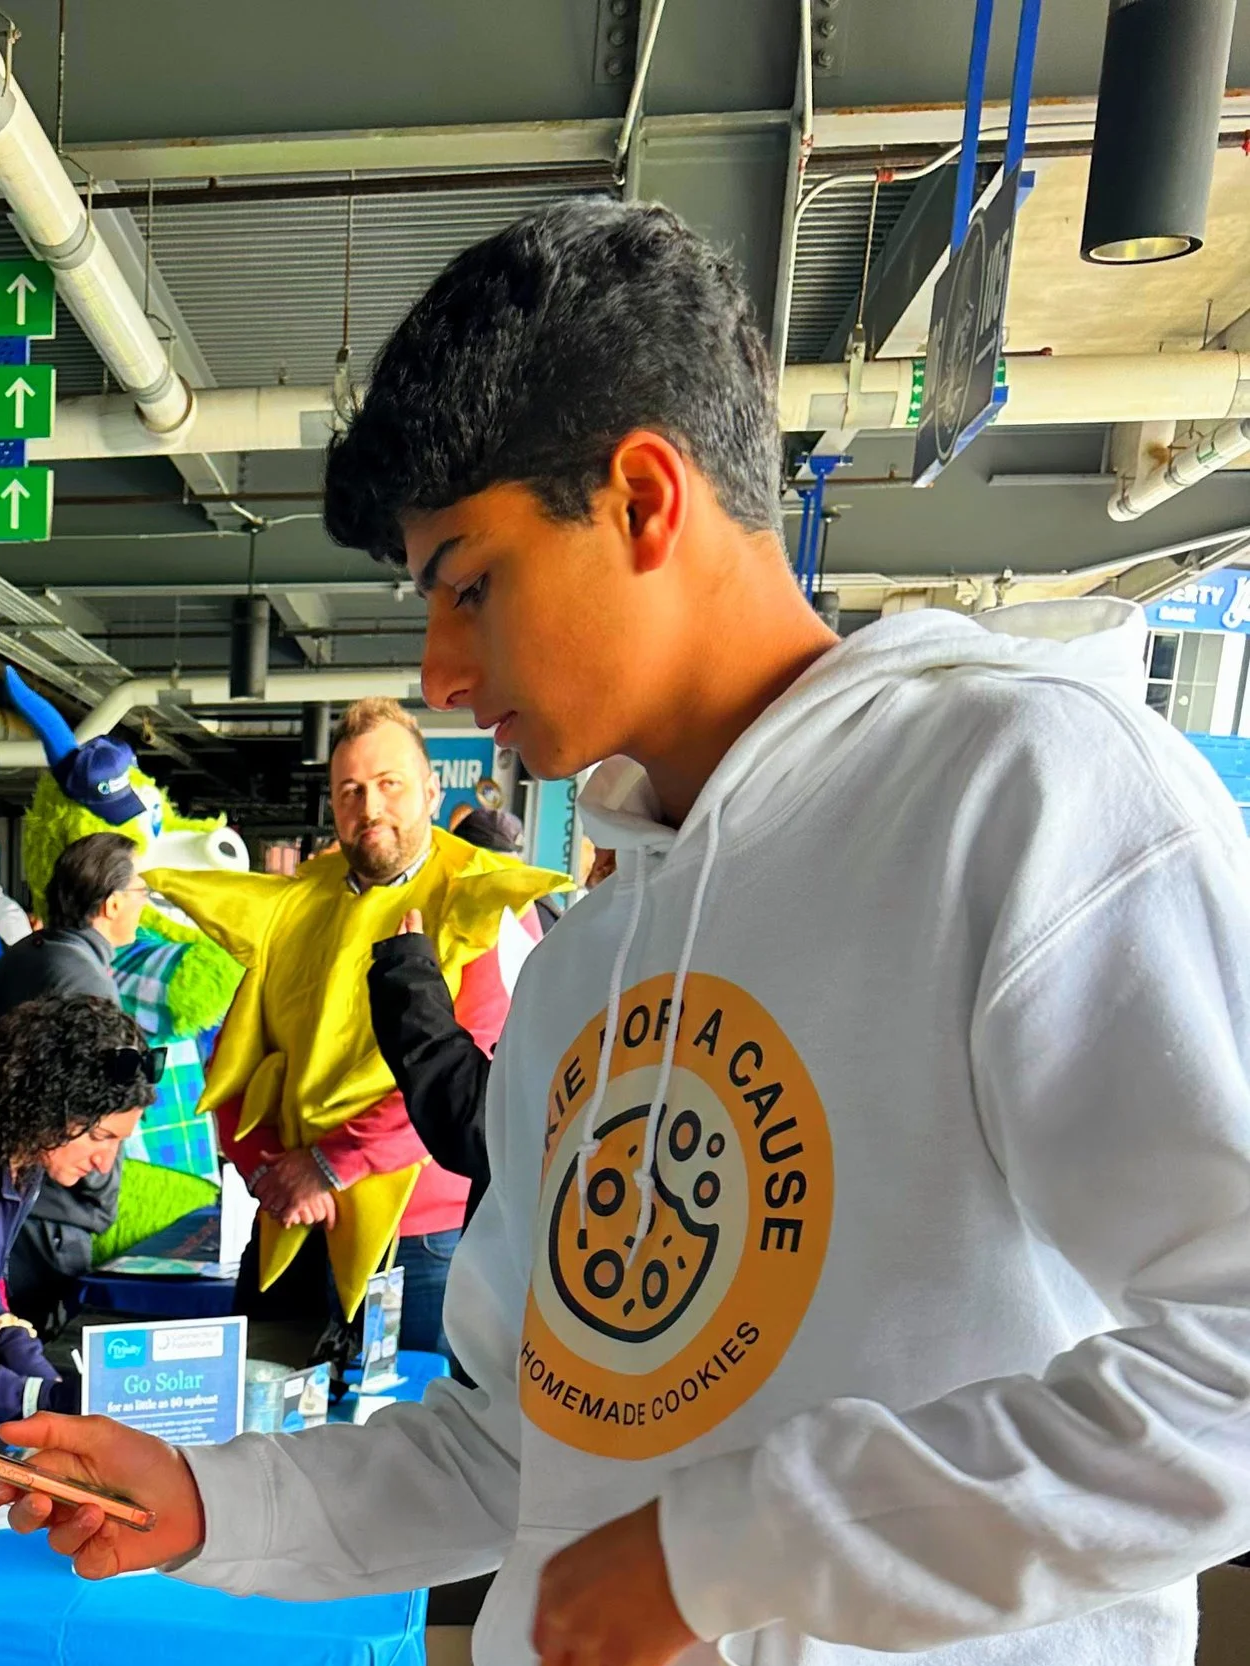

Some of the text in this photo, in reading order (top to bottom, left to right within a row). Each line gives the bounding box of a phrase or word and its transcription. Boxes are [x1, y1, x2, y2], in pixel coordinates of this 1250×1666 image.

[599, 998, 685, 1052] OR
[693, 1008, 723, 1056] A
[728, 1040, 807, 1254] CAUSE
[124, 1369, 204, 1394] Go Solar
[521, 1321, 760, 1426] HOMEMADE COOKIES
